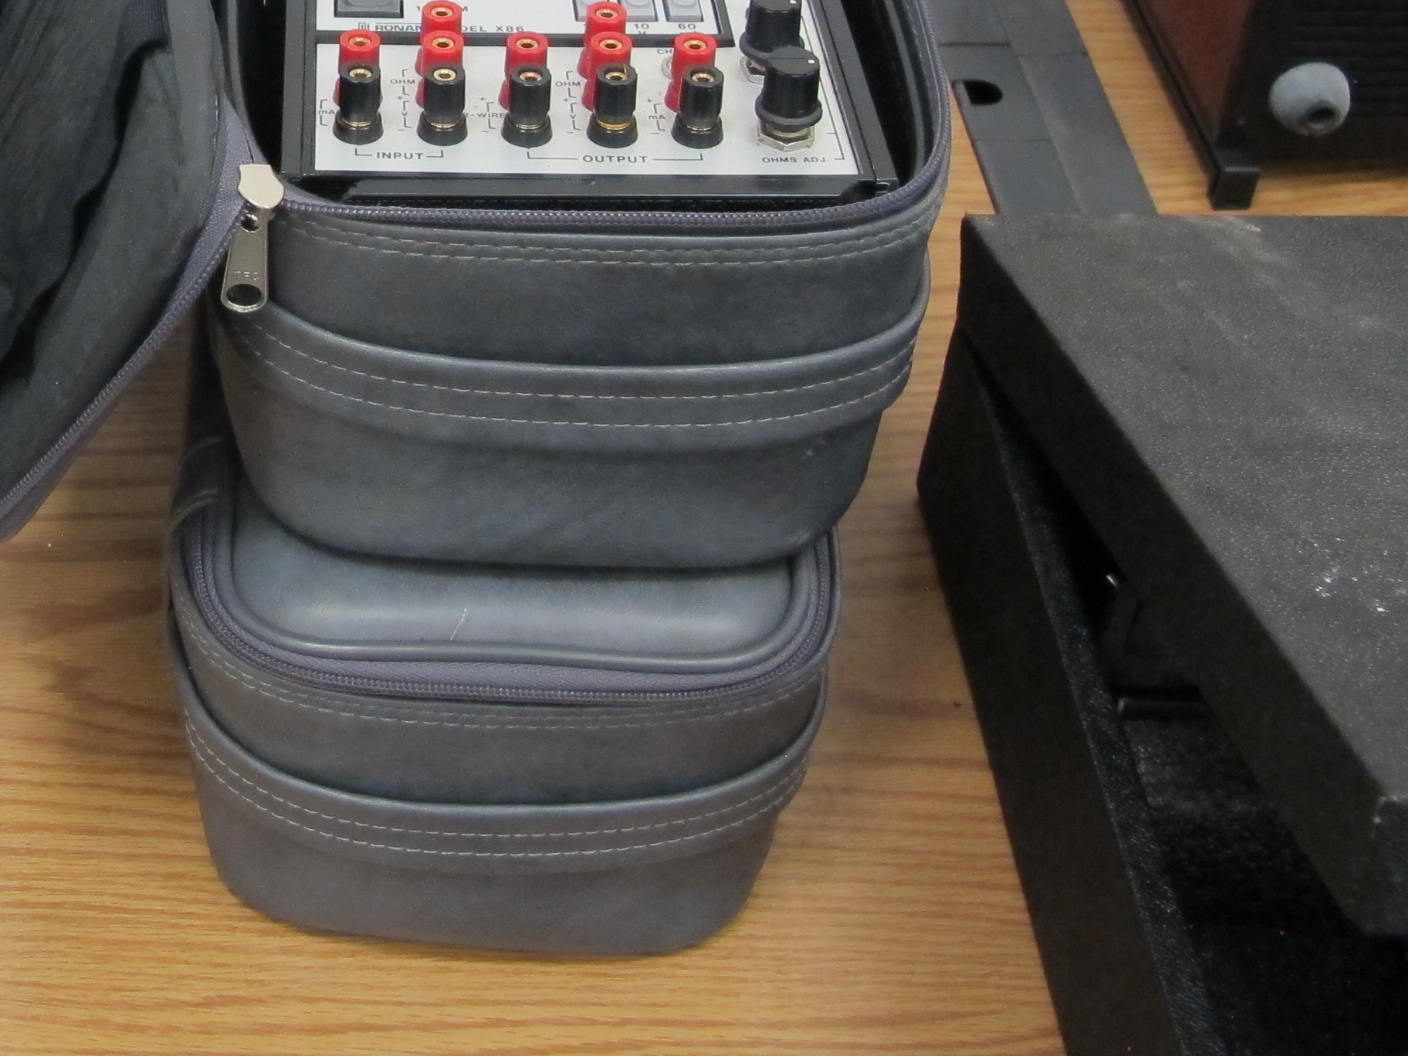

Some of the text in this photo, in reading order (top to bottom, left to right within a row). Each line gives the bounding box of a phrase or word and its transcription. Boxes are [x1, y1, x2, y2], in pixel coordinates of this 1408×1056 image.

[495, 25, 524, 33] X86
[375, 151, 424, 160] INPUT
[582, 154, 648, 164] OUTPUT
[761, 156, 797, 164] OHMS
